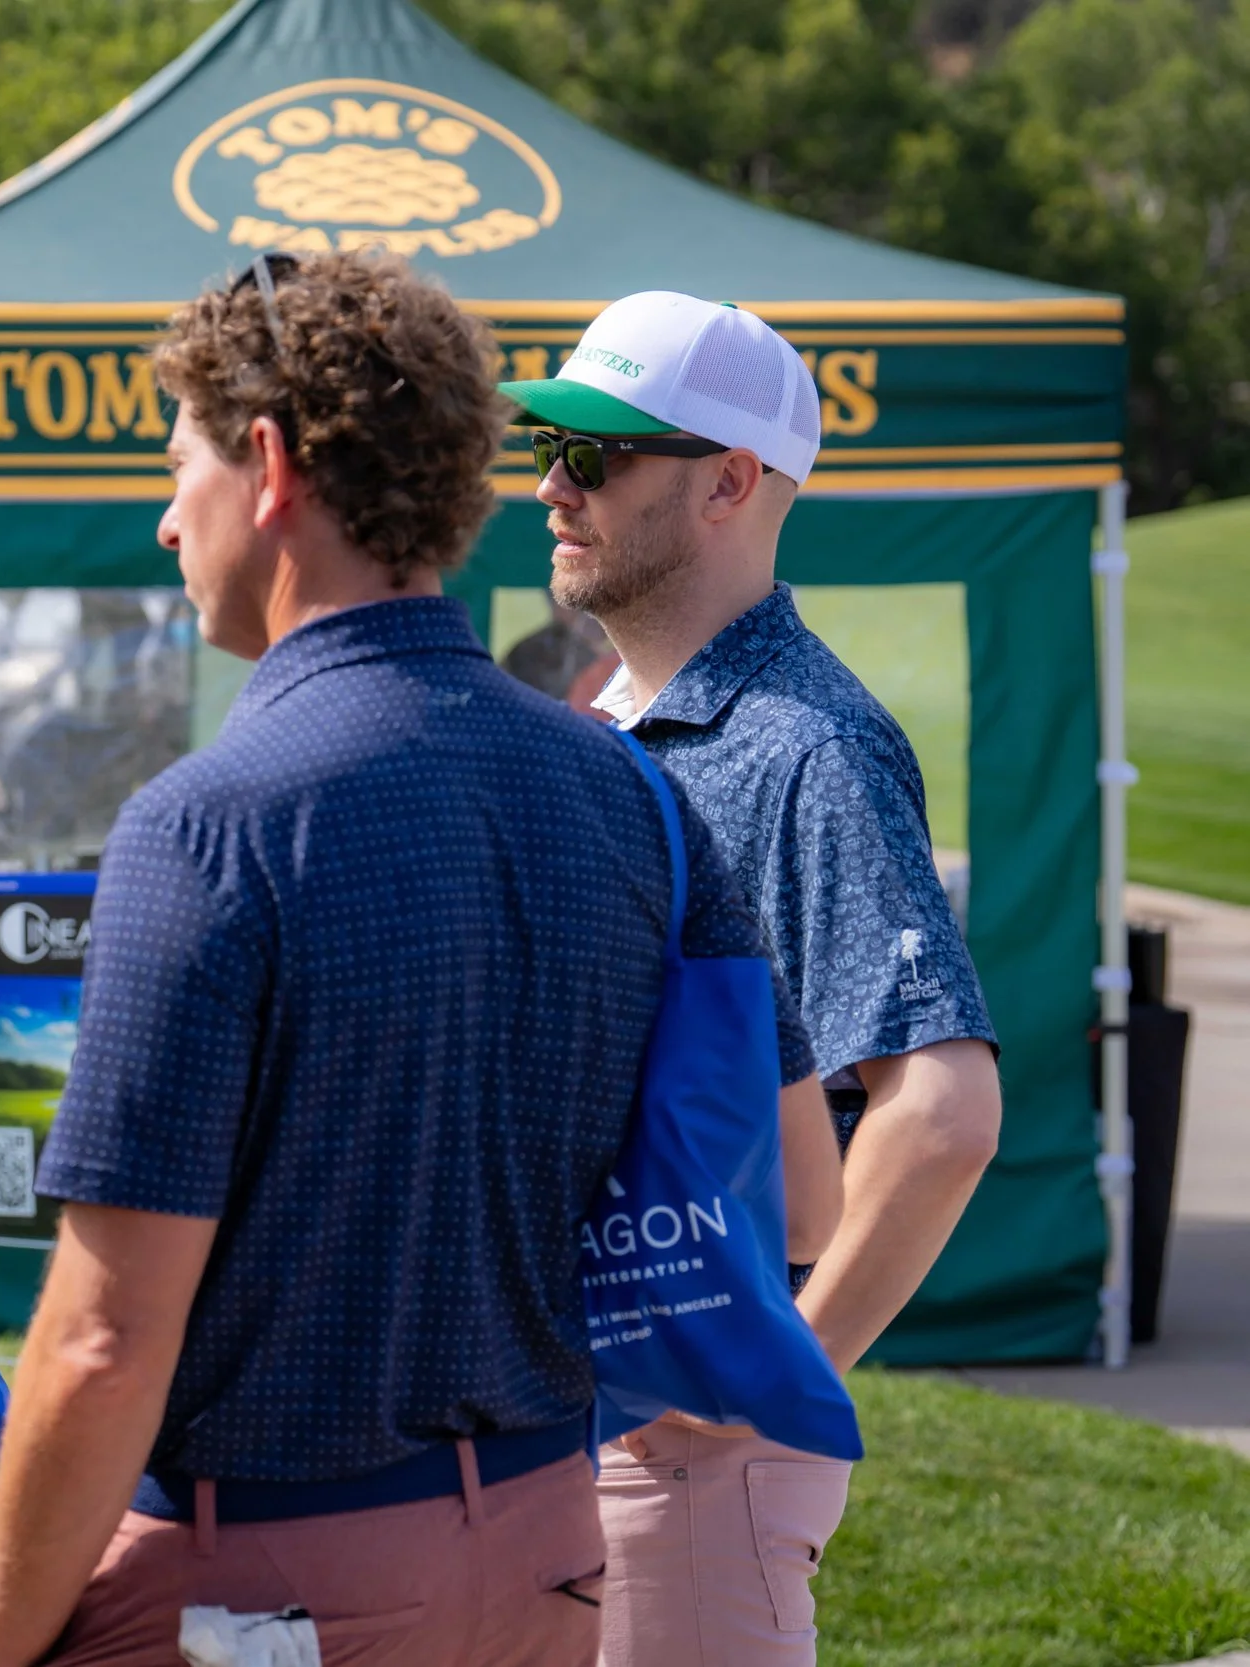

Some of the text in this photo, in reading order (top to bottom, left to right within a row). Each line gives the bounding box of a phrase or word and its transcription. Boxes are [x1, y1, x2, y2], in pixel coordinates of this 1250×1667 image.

[217, 98, 478, 165] TOM'S
[898, 977, 941, 994] McCall
[901, 988, 944, 1001] Golf Club
[583, 1257, 704, 1288] INTEGRATION
[674, 1293, 732, 1315] ANGELES
